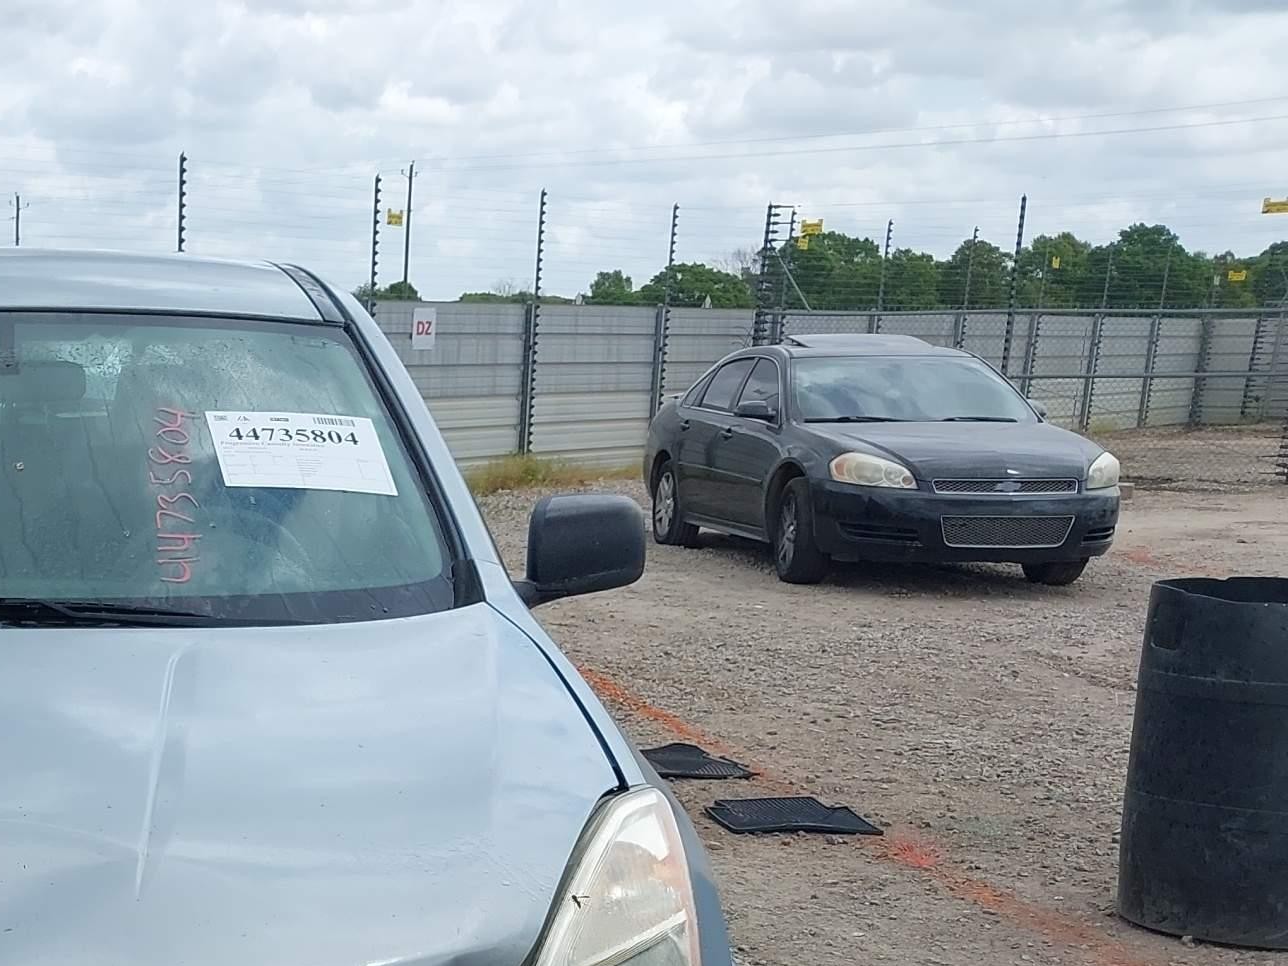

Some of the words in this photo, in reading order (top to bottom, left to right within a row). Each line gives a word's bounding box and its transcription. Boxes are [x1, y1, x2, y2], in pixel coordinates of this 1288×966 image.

[416, 320, 433, 336] DZ
[228, 426, 360, 446] 44735804
[148, 407, 203, 584] 44735804
